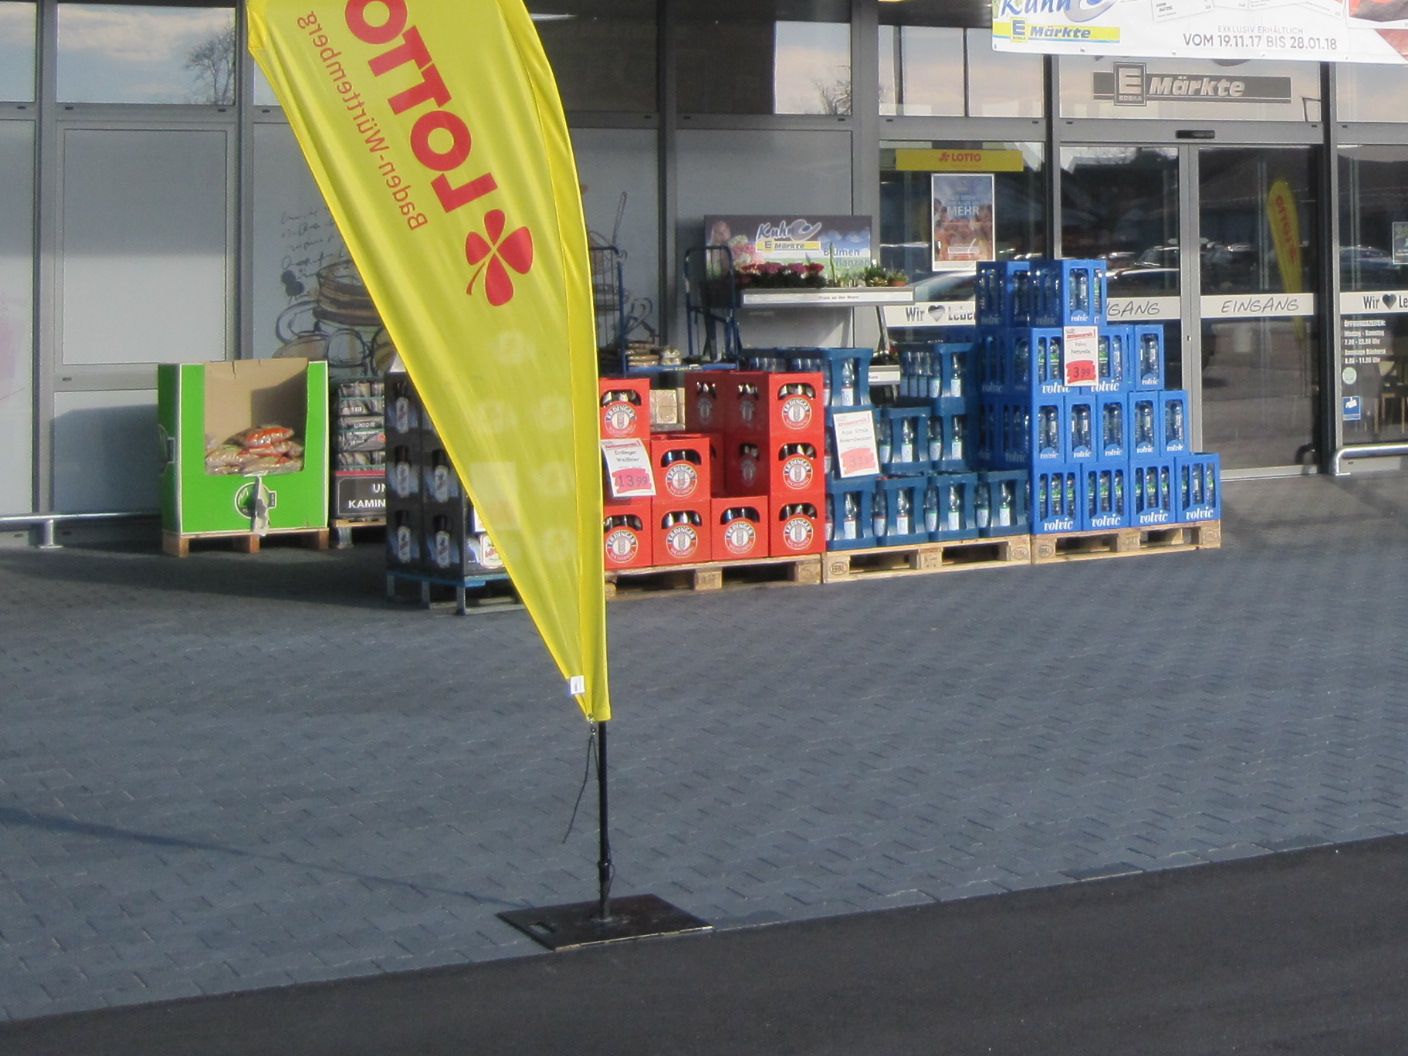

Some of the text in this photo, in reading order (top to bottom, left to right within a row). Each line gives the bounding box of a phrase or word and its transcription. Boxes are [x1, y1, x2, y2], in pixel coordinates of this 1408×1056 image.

[1030, 24, 1091, 39] Märkte
[1218, 25, 1304, 35] EXKLUSIV ERHÄLTLICH
[1183, 33, 1337, 50] VOM 19.11.17 BIS 28.01.18
[1150, 76, 1245, 97] Märkte
[952, 152, 982, 163] LOTTO
[947, 205, 979, 217] MEHR
[823, 247, 860, 257] Bumen
[1221, 297, 1300, 314] EINGANG
[1363, 295, 1380, 310] Wir
[905, 306, 925, 322] Wir
[1139, 510, 1169, 524] volvic
[1186, 506, 1214, 520] volvic
[1044, 518, 1074, 532] volvic
[1092, 514, 1121, 528] volvic
